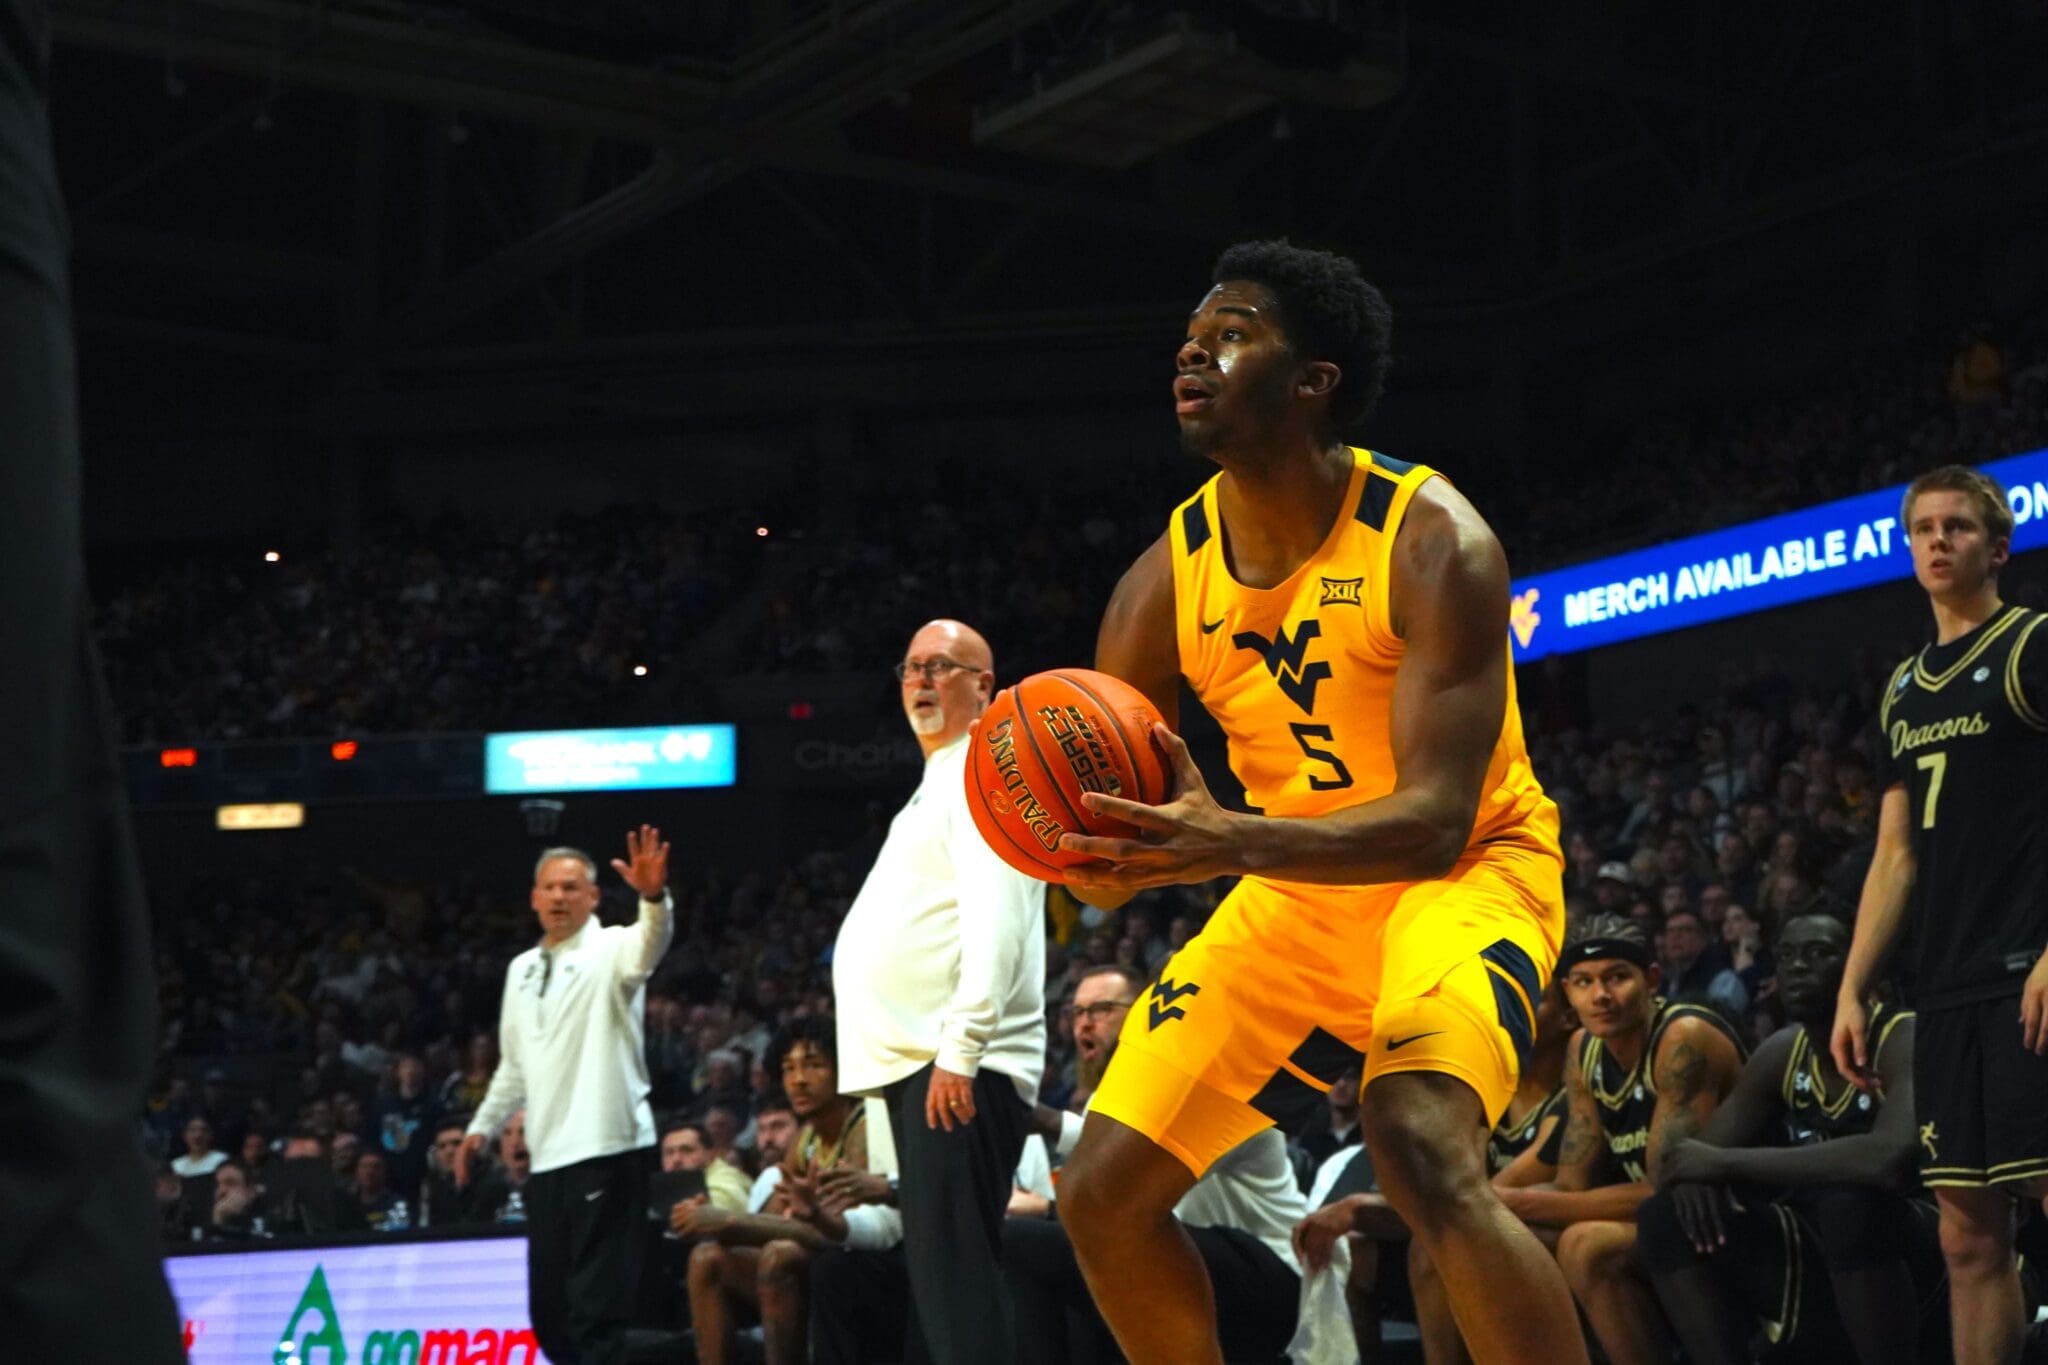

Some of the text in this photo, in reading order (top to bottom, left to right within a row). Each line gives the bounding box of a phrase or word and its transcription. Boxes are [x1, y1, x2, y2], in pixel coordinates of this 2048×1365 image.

[1564, 572, 1669, 627] MERCH
[1674, 529, 1848, 603] AVAILABLE
[1853, 517, 1896, 561] AT
[1037, 704, 1106, 818] EGACY
[1288, 722, 1354, 791] 5
[1889, 711, 1991, 760] Deacons
[987, 718, 1063, 853] SPALDING
[1916, 752, 1947, 829] 7
